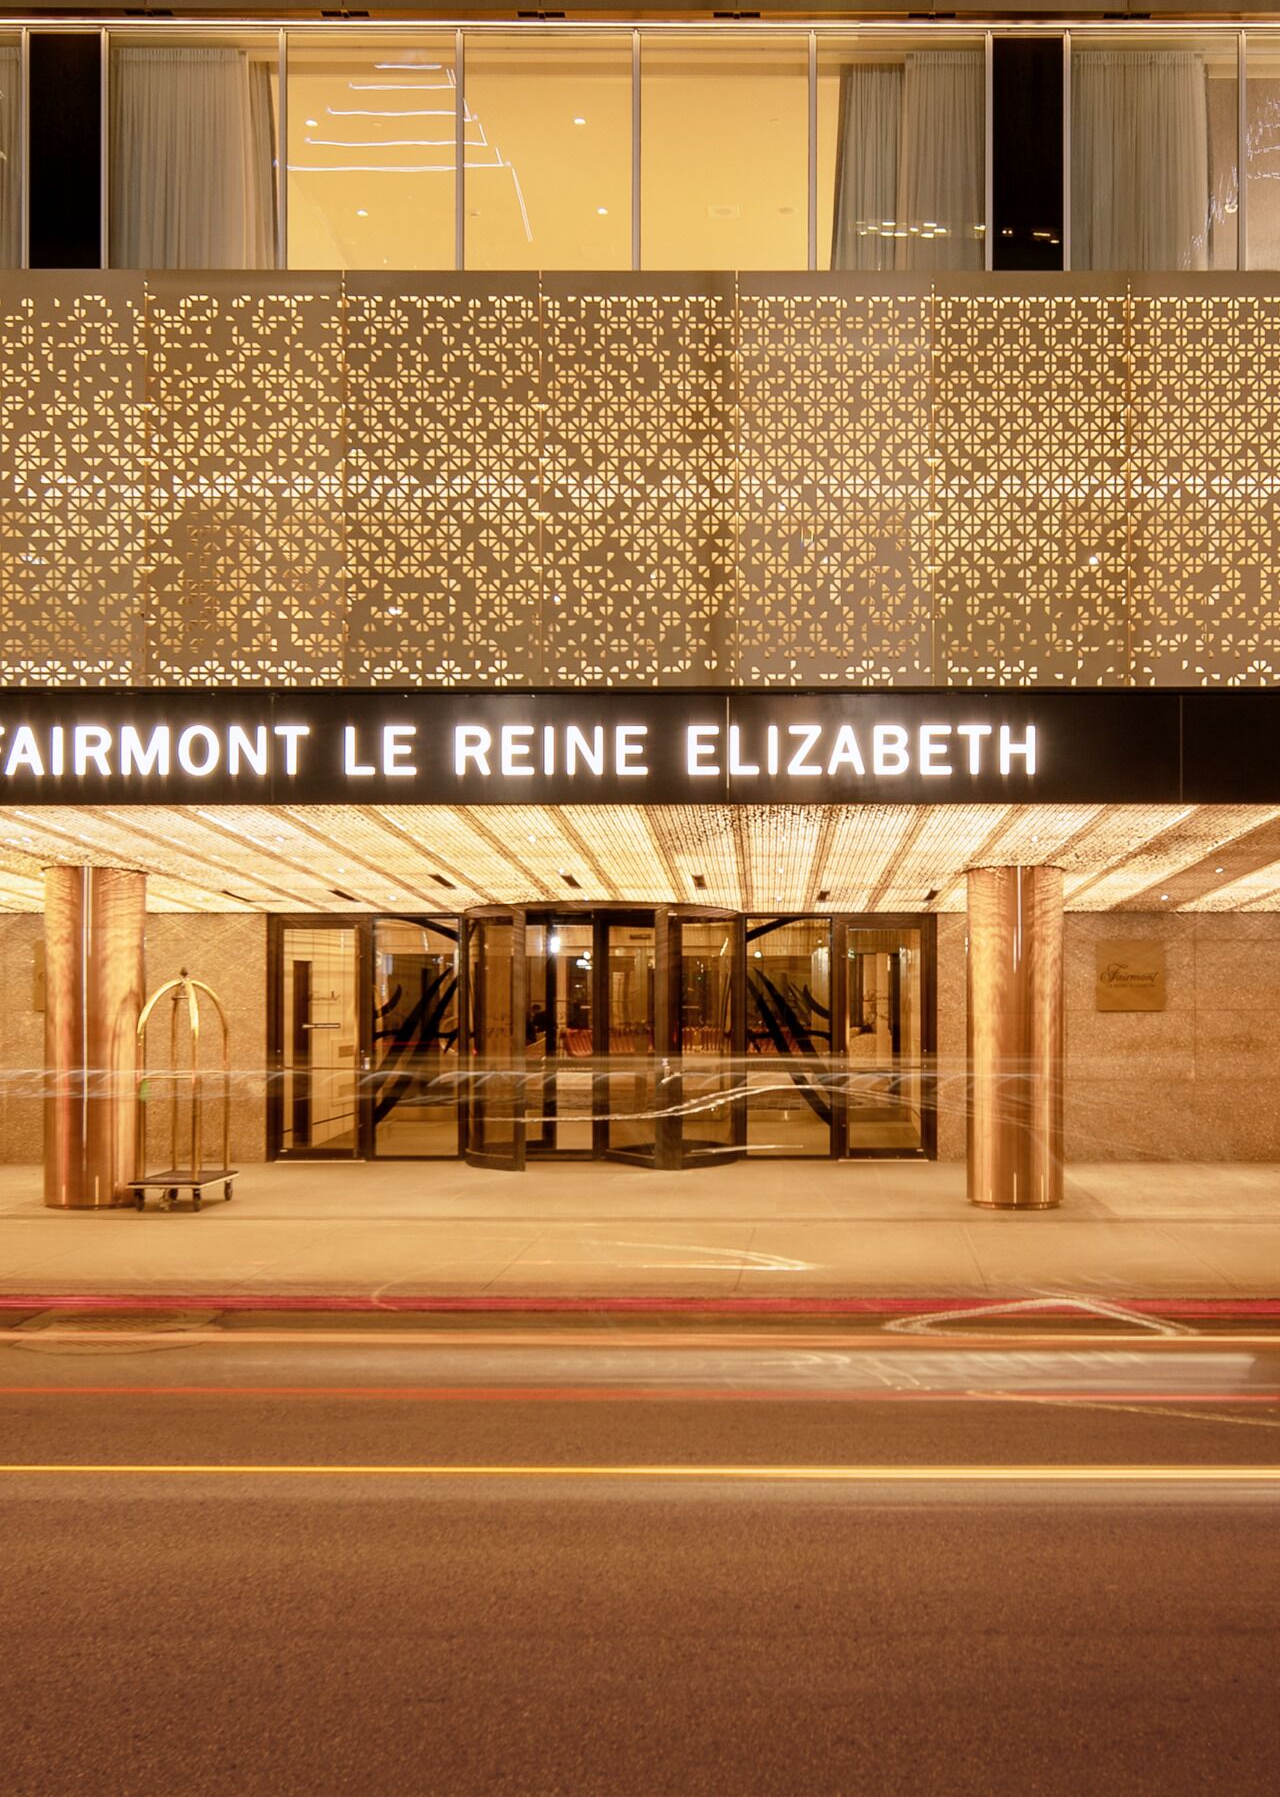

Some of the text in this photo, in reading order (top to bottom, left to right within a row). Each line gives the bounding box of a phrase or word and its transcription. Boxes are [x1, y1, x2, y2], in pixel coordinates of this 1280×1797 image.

[344, 724, 417, 776] LE
[453, 724, 648, 776] REINE
[686, 724, 1036, 776] ELIZABETH
